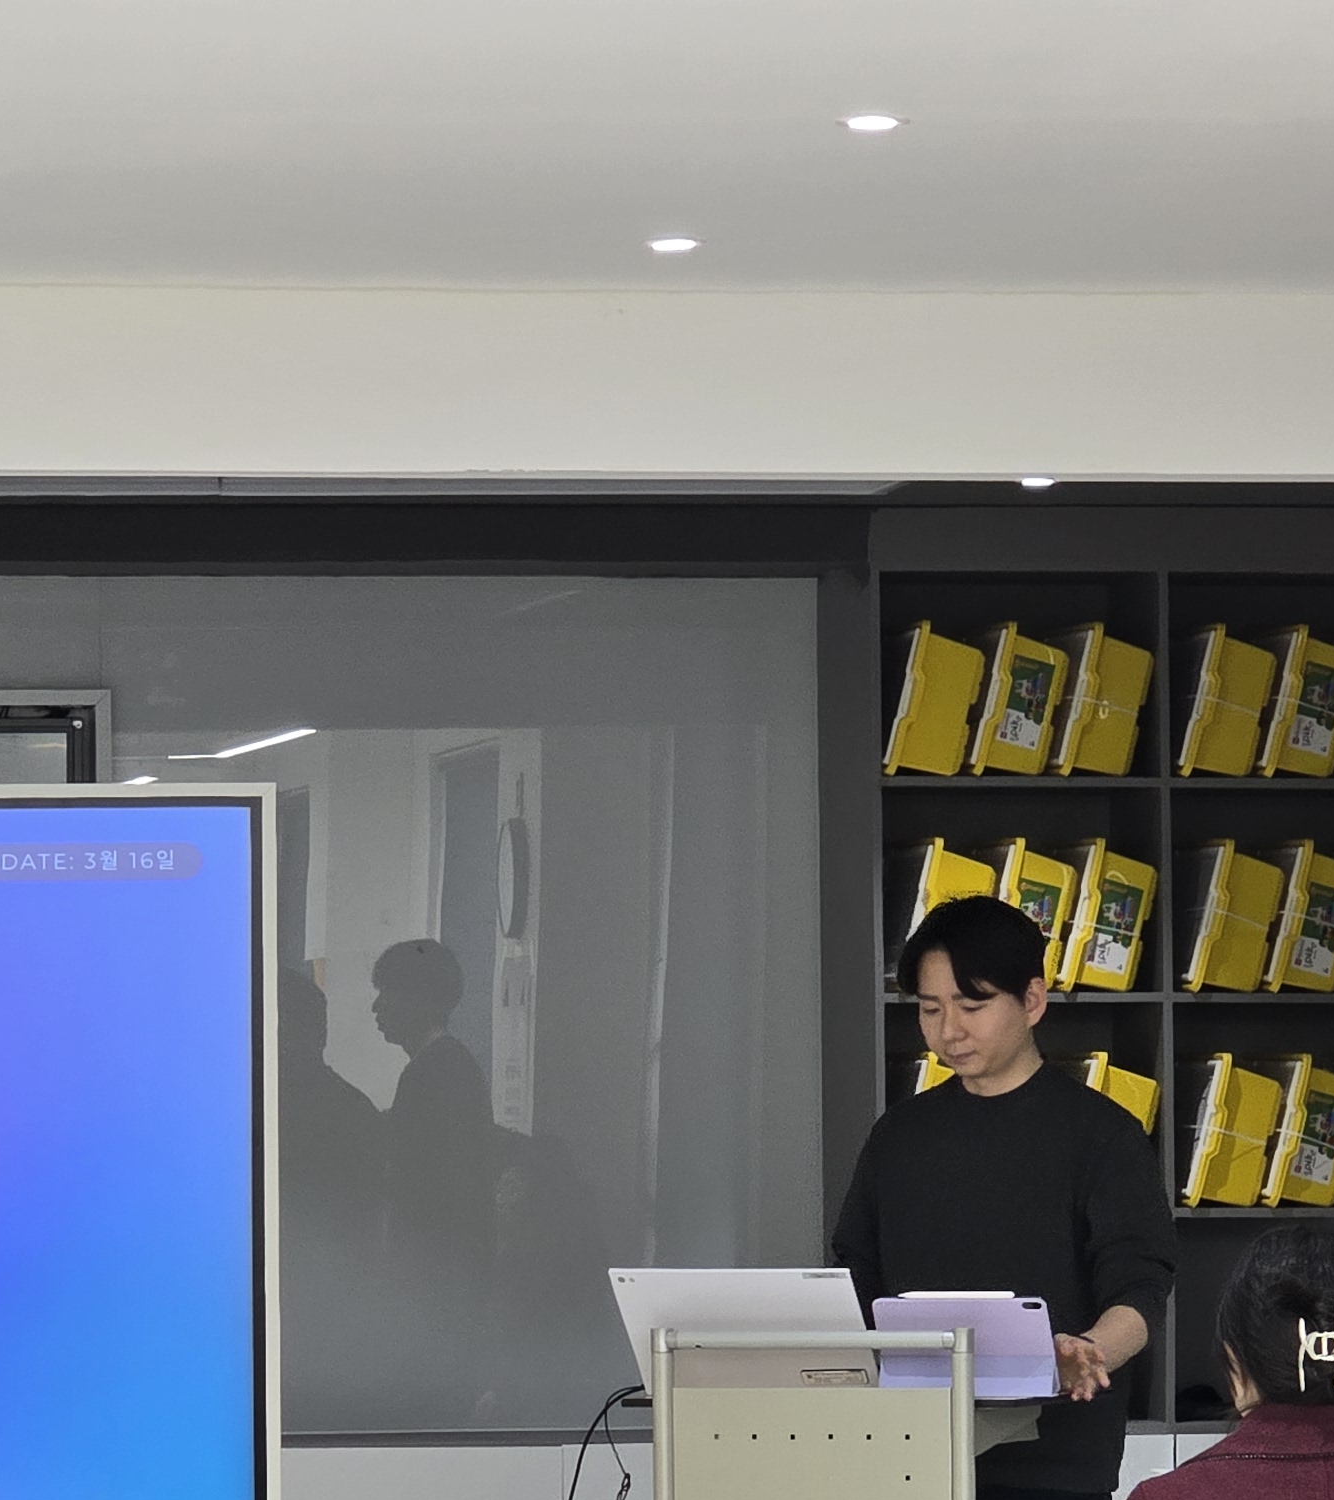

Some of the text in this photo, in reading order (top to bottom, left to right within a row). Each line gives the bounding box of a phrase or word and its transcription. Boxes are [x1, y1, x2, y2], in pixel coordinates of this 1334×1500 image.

[1, 848, 175, 871] DATE: 3월 16일
